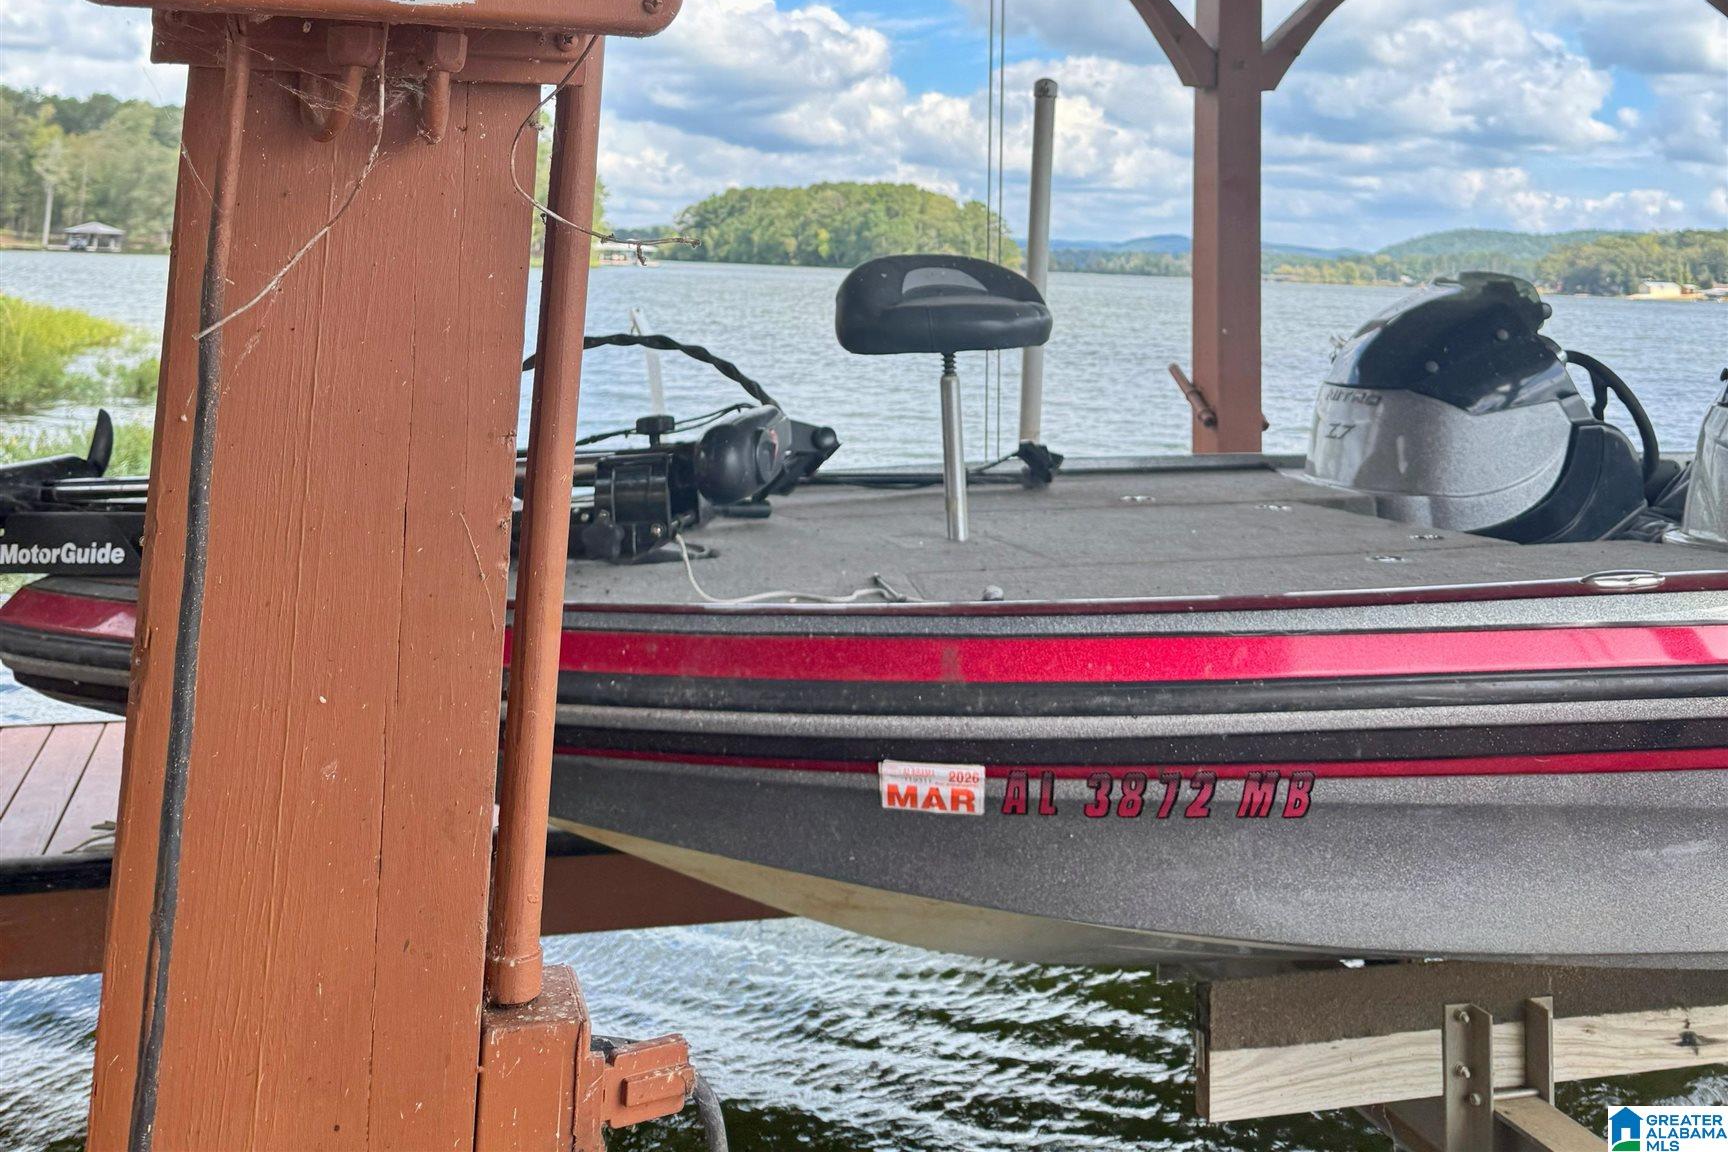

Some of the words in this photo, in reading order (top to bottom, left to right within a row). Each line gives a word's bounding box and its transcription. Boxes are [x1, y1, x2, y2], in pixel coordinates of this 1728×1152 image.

[1325, 422, 1356, 439] Z7
[0, 542, 125, 564] MotorGuide
[948, 770, 980, 784] 2026
[887, 784, 976, 813] MAR
[1001, 770, 1057, 816] AL
[1083, 771, 1217, 819] 3872
[1236, 770, 1316, 818] MB
